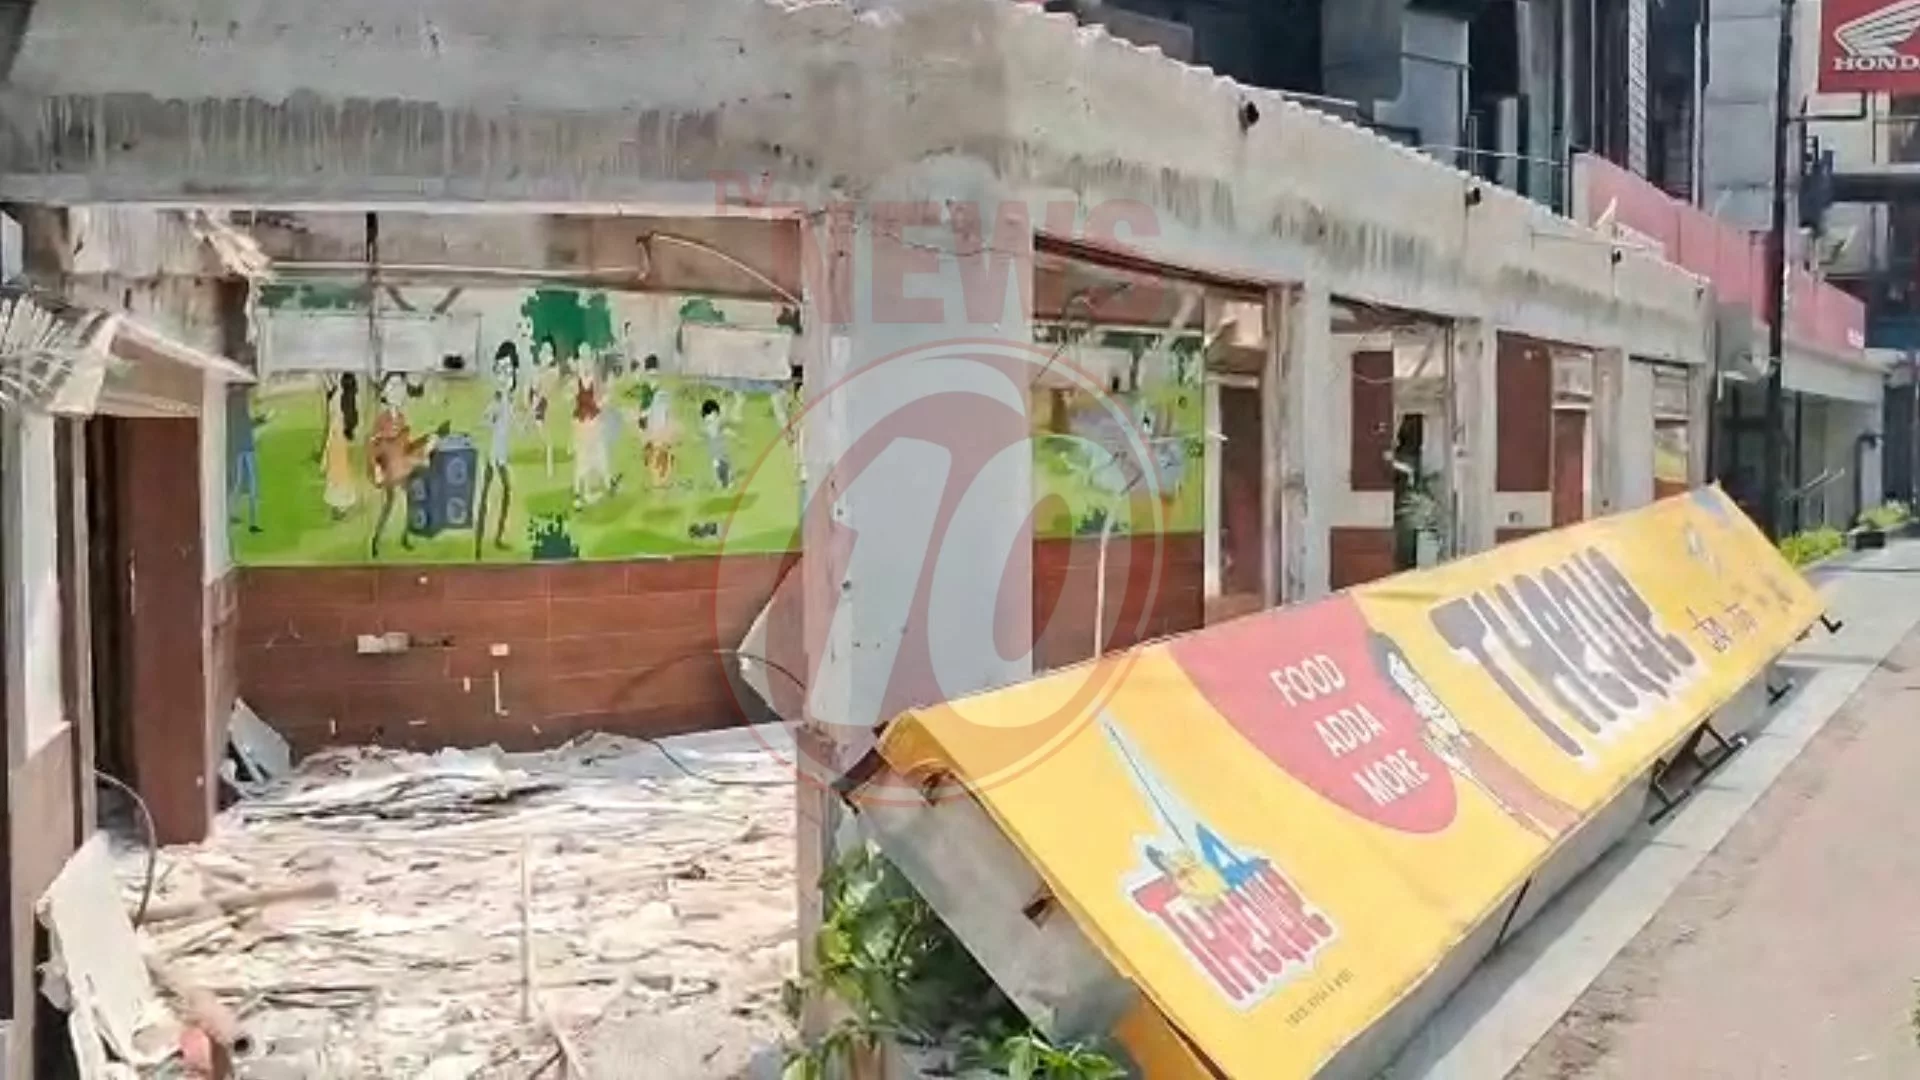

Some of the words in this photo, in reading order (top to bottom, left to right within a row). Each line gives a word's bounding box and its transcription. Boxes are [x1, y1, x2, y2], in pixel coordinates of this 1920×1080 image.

[1833, 56, 1920, 72] HOND
[1270, 654, 1346, 707] FOOD
[1313, 703, 1387, 758] ADDA
[1352, 748, 1430, 806] MORE
